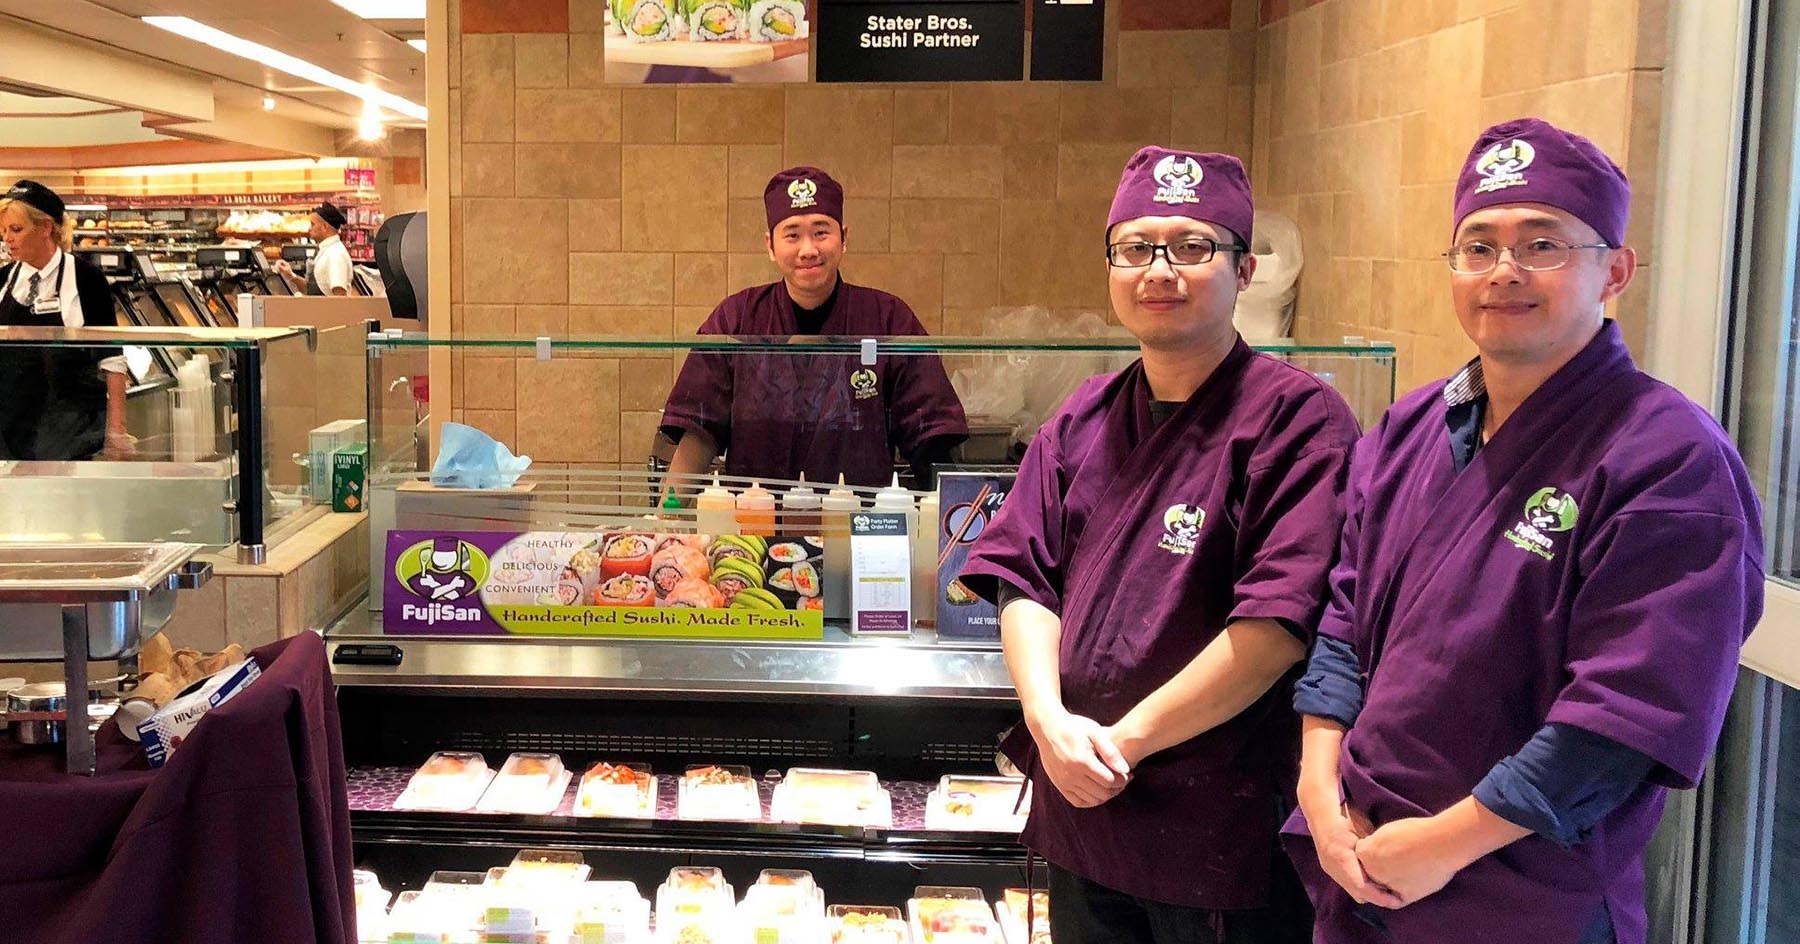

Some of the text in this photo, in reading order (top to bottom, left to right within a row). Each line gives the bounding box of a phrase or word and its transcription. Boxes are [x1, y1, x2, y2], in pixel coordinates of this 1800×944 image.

[867, 14, 973, 31] Stater Bros.
[860, 32, 980, 48] Sushi Partner
[337, 455, 361, 464] VINYL
[527, 540, 574, 549] HEALTHY
[502, 562, 559, 571] DELICIOUS
[485, 584, 557, 594] CONVENIENT
[402, 603, 481, 626] FujiSan
[502, 609, 805, 628] Handcrafted Sushi. Made Fresh.
[968, 617, 983, 625] PLACE
[984, 617, 997, 625] YOUR
